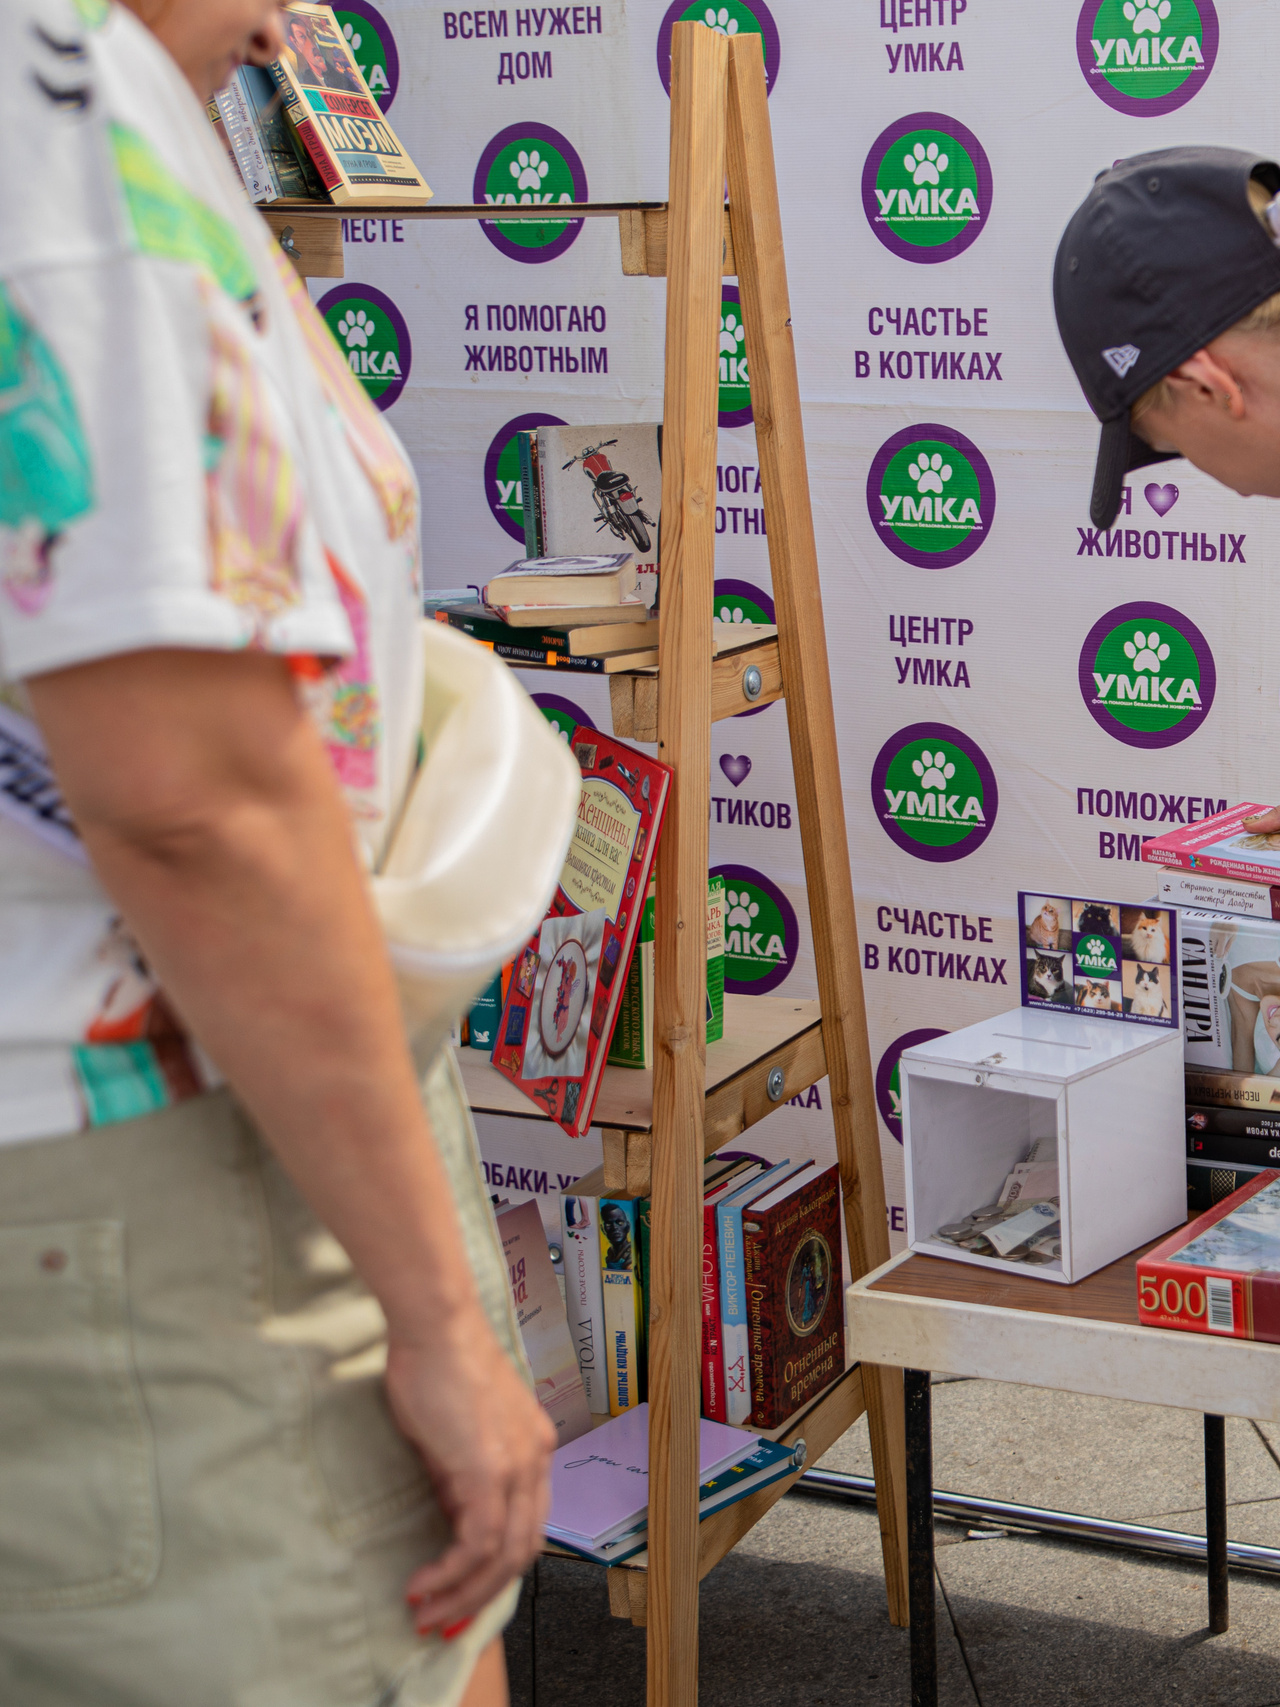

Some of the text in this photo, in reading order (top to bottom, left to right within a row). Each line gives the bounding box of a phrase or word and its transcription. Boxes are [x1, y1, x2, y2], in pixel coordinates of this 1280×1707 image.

[444, 6, 602, 39] ВСЕМ НУЖЕН
[880, 0, 966, 32] ЦЕНТР
[885, 42, 964, 74] УМКА
[1090, 36, 1204, 64] УМКА
[497, 51, 552, 85] ДОМ
[324, 94, 377, 117] СОМЕРСЕТ
[301, 126, 320, 151] ГРОШ
[319, 115, 400, 155] МОЭМ
[319, 159, 336, 183] ЛУНА
[874, 188, 980, 215] УМКА
[342, 219, 405, 244] ЕСТЕ
[465, 304, 606, 333] Я ПОМОГАЮ
[868, 307, 988, 336] СЧАСТЬЕ
[343, 349, 402, 375] МКА
[464, 345, 608, 373] ЖИВОТНЫМ
[855, 351, 1003, 381] В КОТИКАХ
[879, 495, 983, 523] УМКА
[1077, 525, 1246, 563] ЖИВОТНЫХ
[889, 615, 973, 647] ЦЕНТР
[895, 657, 971, 688] УМКА
[1092, 672, 1202, 704] УМКА
[709, 796, 793, 830] ТИКОВ
[883, 789, 986, 821] УМКА
[1076, 787, 1228, 825] ПОМОЖЕМ
[1147, 854, 1183, 866] ПОКАТИЛОВА
[1152, 849, 1177, 859] НАТАЛЬЯ
[1209, 858, 1246, 872] РОЖДЕННАЯ
[1245, 863, 1263, 874] БЫТЬ
[1180, 880, 1214, 894] Странное
[877, 906, 993, 943] СЧАСТЬЕ
[864, 943, 1007, 985] В КОТИКАХ
[1075, 953, 1118, 970] УМКА
[1182, 937, 1214, 1044] САНДРА
[1234, 1090, 1260, 1102] ПЕСНЯ
[1246, 1126, 1269, 1138] КРОВИ
[722, 1215, 739, 1317] ВИКТОР ПЕЛЕВИН
[1139, 1275, 1207, 1319] 500
[750, 1289, 765, 1352] Огненные
[577, 1317, 596, 1375] ТОДД
[783, 1331, 839, 1385] Огненные
[615, 1330, 630, 1408] ЗОЛОТЫЕ КОЛДУНЫ
[751, 1353, 765, 1403] времена
[791, 1353, 834, 1402] времена
